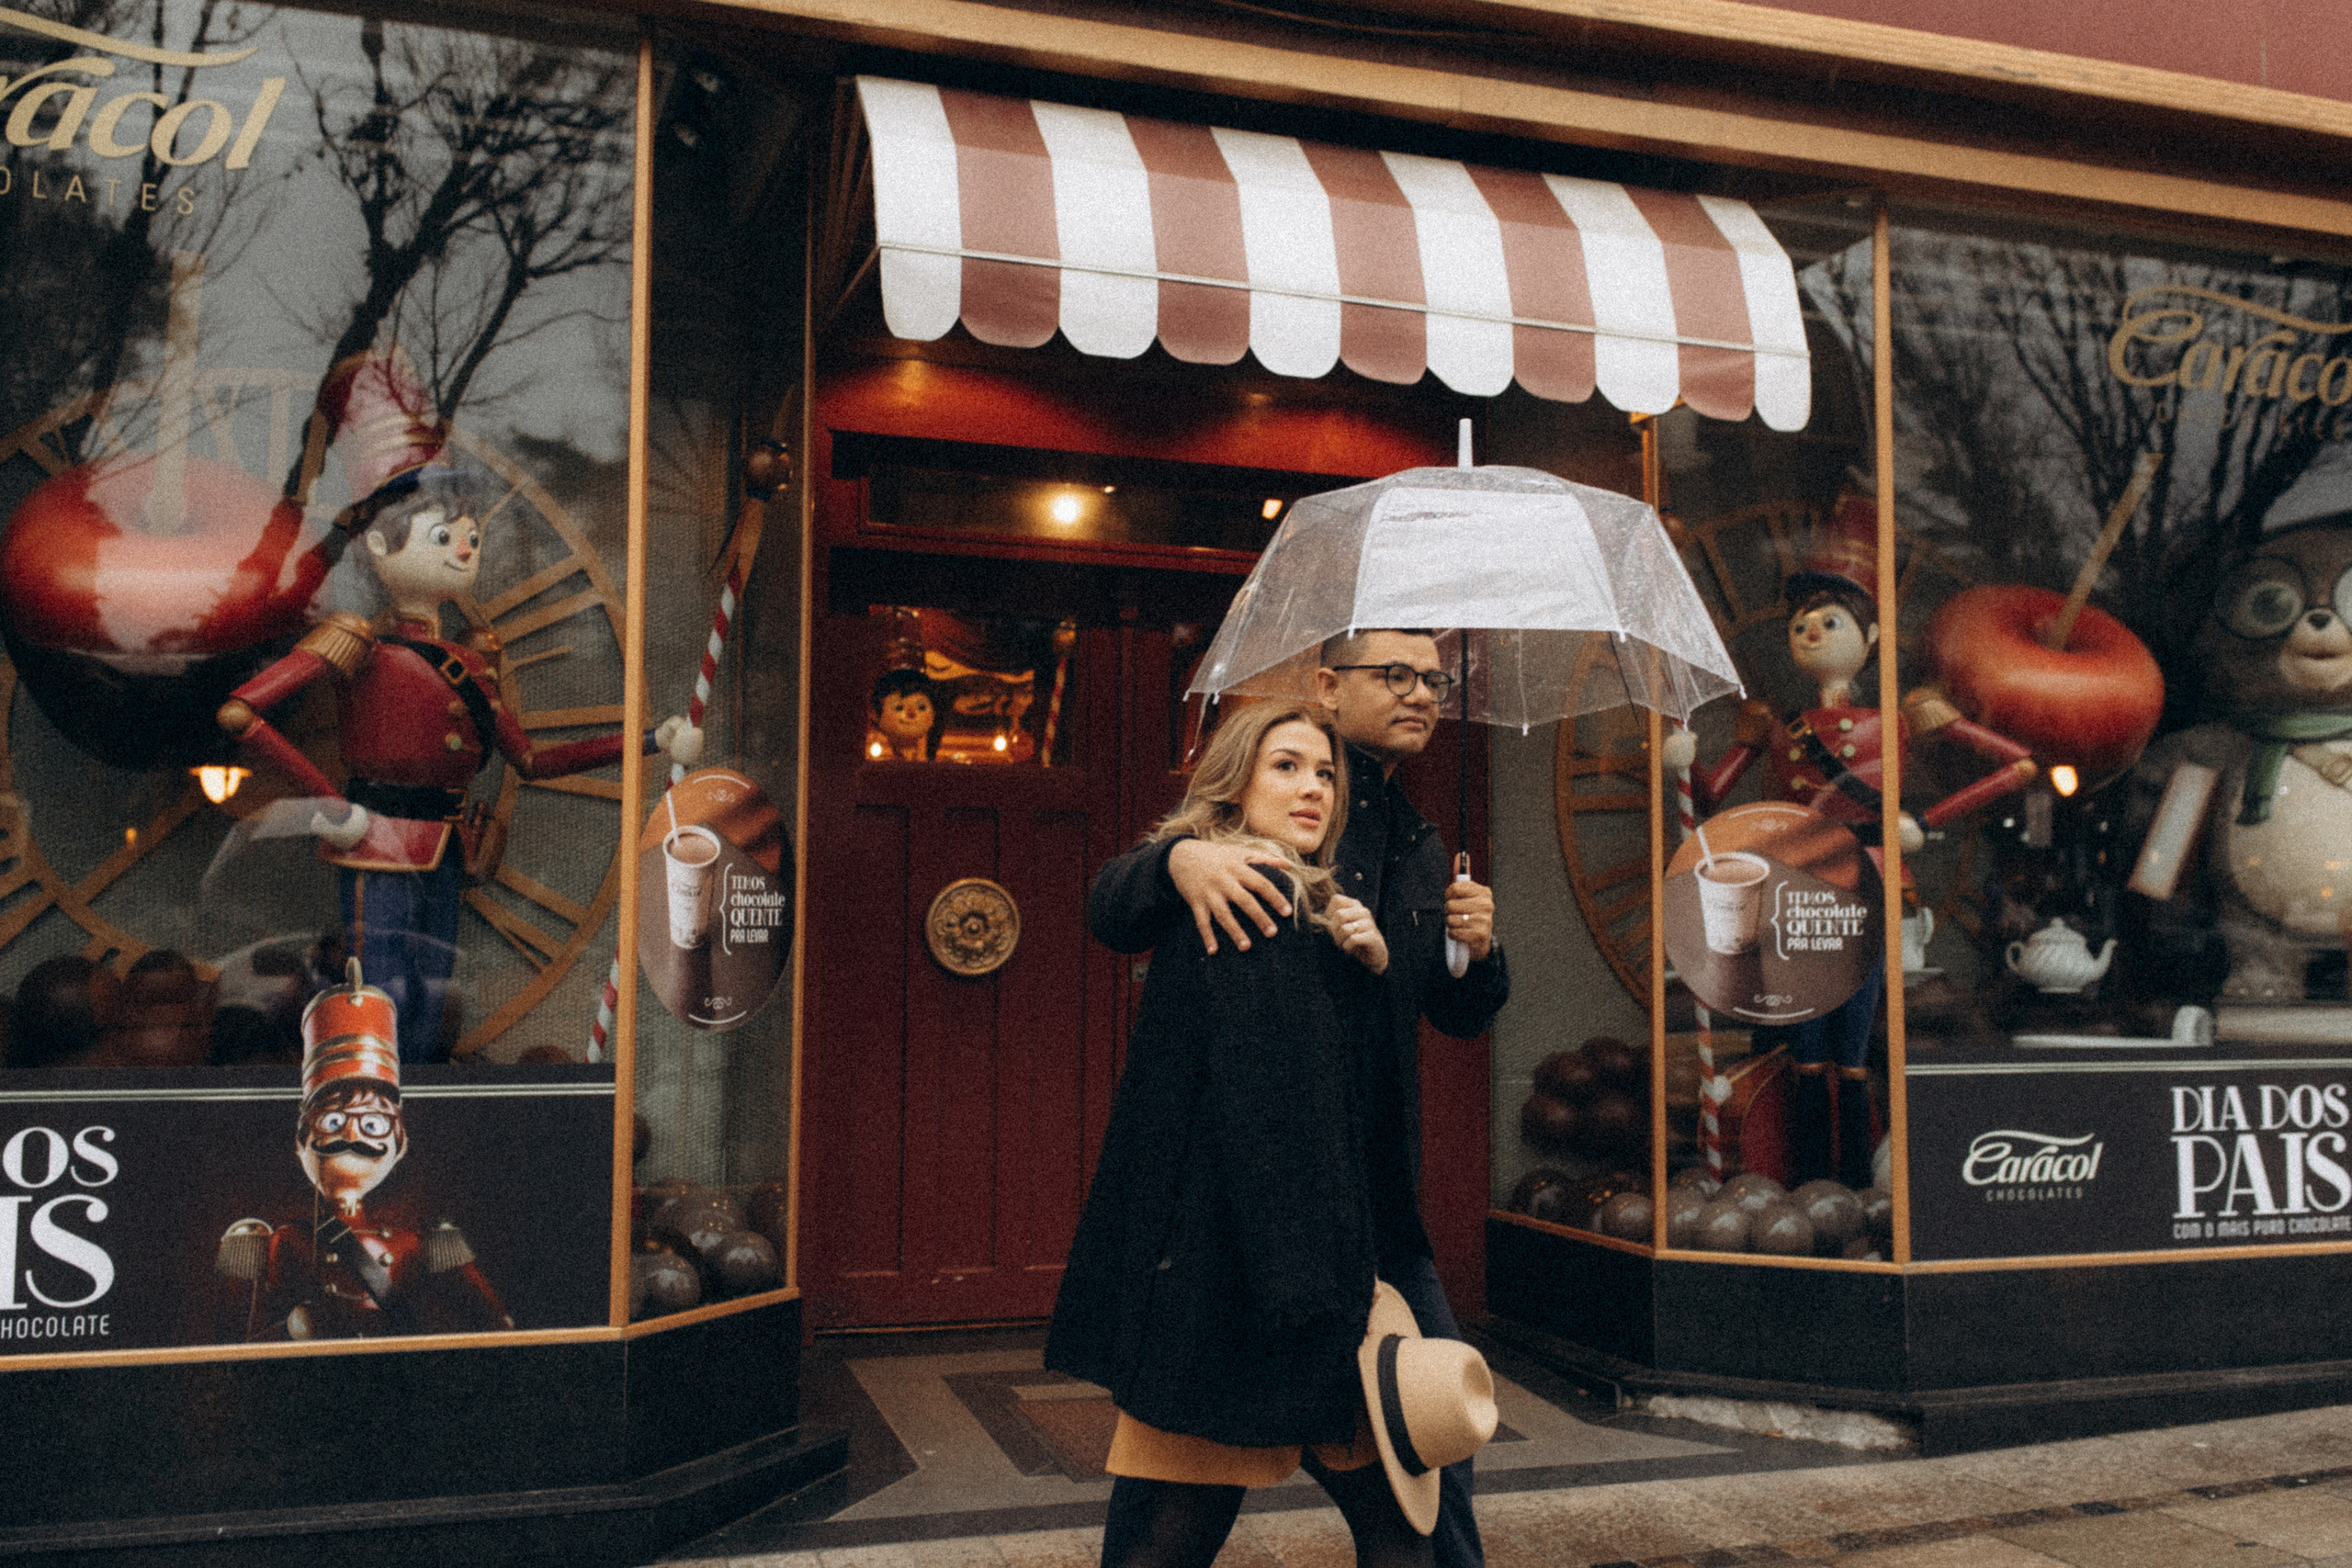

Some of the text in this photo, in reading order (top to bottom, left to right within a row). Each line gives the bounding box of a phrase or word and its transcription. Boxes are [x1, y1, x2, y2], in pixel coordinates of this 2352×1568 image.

[729, 891, 786, 907] chocolate
[729, 908, 783, 928] QUENTE
[1786, 904, 1868, 919] chocolate
[1786, 919, 1864, 937] QUENTE
[2170, 1083, 2349, 1132] DIA DOS
[2, 1125, 119, 1189] OS
[1962, 1135, 2104, 1186] Caracol
[2170, 1131, 2352, 1218] PAIS
[1985, 1187, 2084, 1202] CHOCOLATES
[1, 1314, 110, 1339] HOCOLATE
